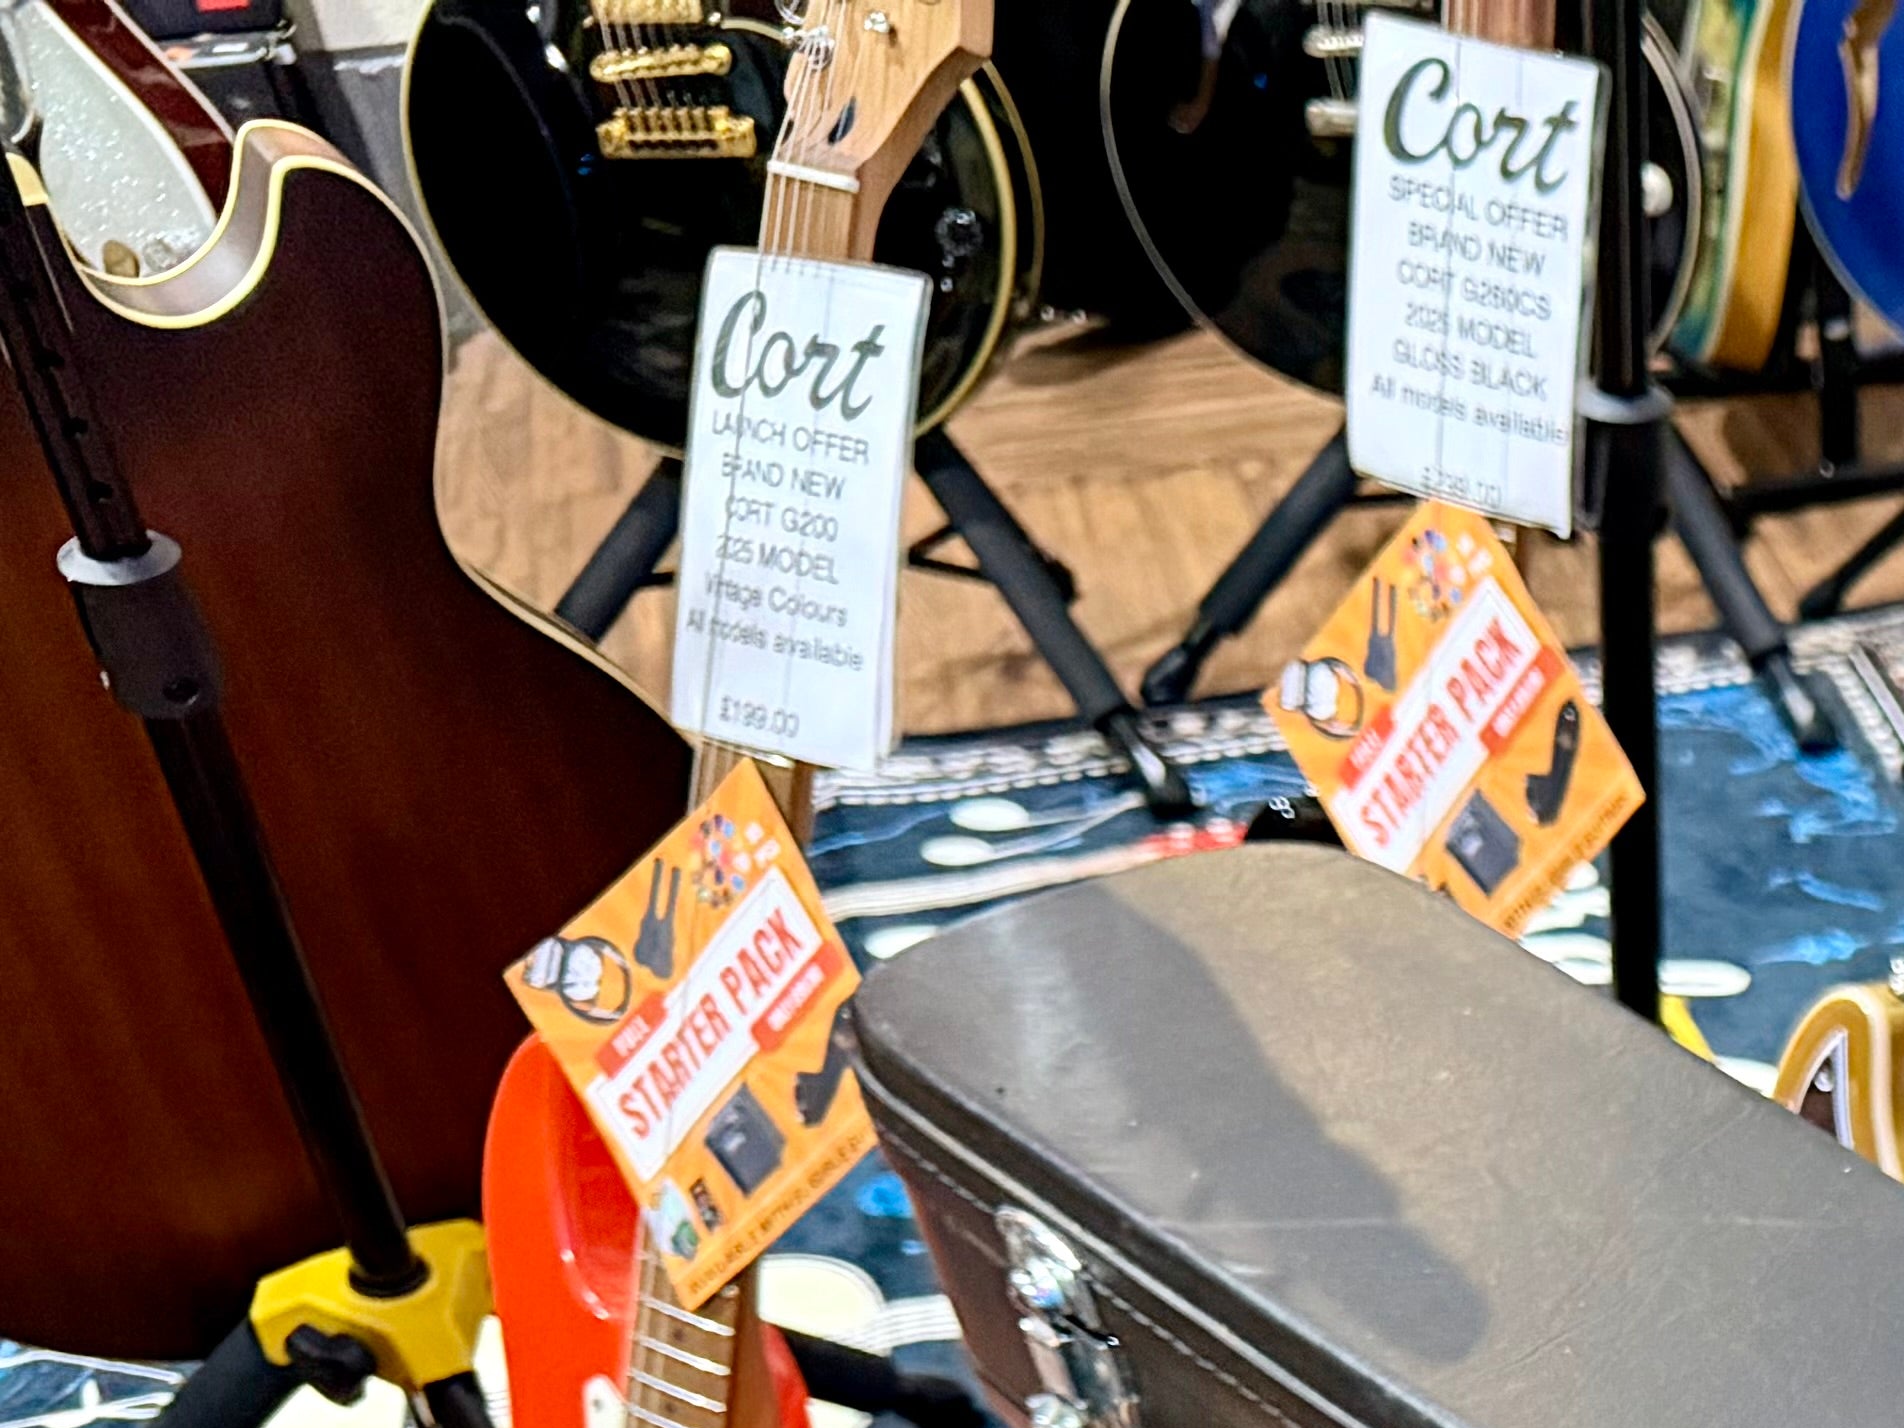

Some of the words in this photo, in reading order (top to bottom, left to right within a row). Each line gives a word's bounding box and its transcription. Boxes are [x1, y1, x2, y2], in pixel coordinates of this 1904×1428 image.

[1383, 57, 1579, 193] Cort
[1388, 174, 1480, 222] SPECIAL
[1484, 199, 1569, 242] OFFER
[1397, 259, 1455, 291] CORT
[1408, 220, 1482, 262] BRAND
[1487, 240, 1547, 277] NEW
[711, 290, 886, 422] Cort
[1456, 314, 1537, 359] MODEL
[1392, 338, 1466, 379] GLOSS
[1469, 360, 1551, 402] BLACK
[792, 426, 870, 465] OFFER
[790, 467, 847, 500] NEW
[758, 543, 840, 585] MODEL
[767, 586, 848, 628] Colours
[1360, 703, 1460, 848] STARTER
[1445, 615, 1522, 721] PACK
[618, 1004, 730, 1141] STARTER
[720, 907, 804, 1018] PACK
